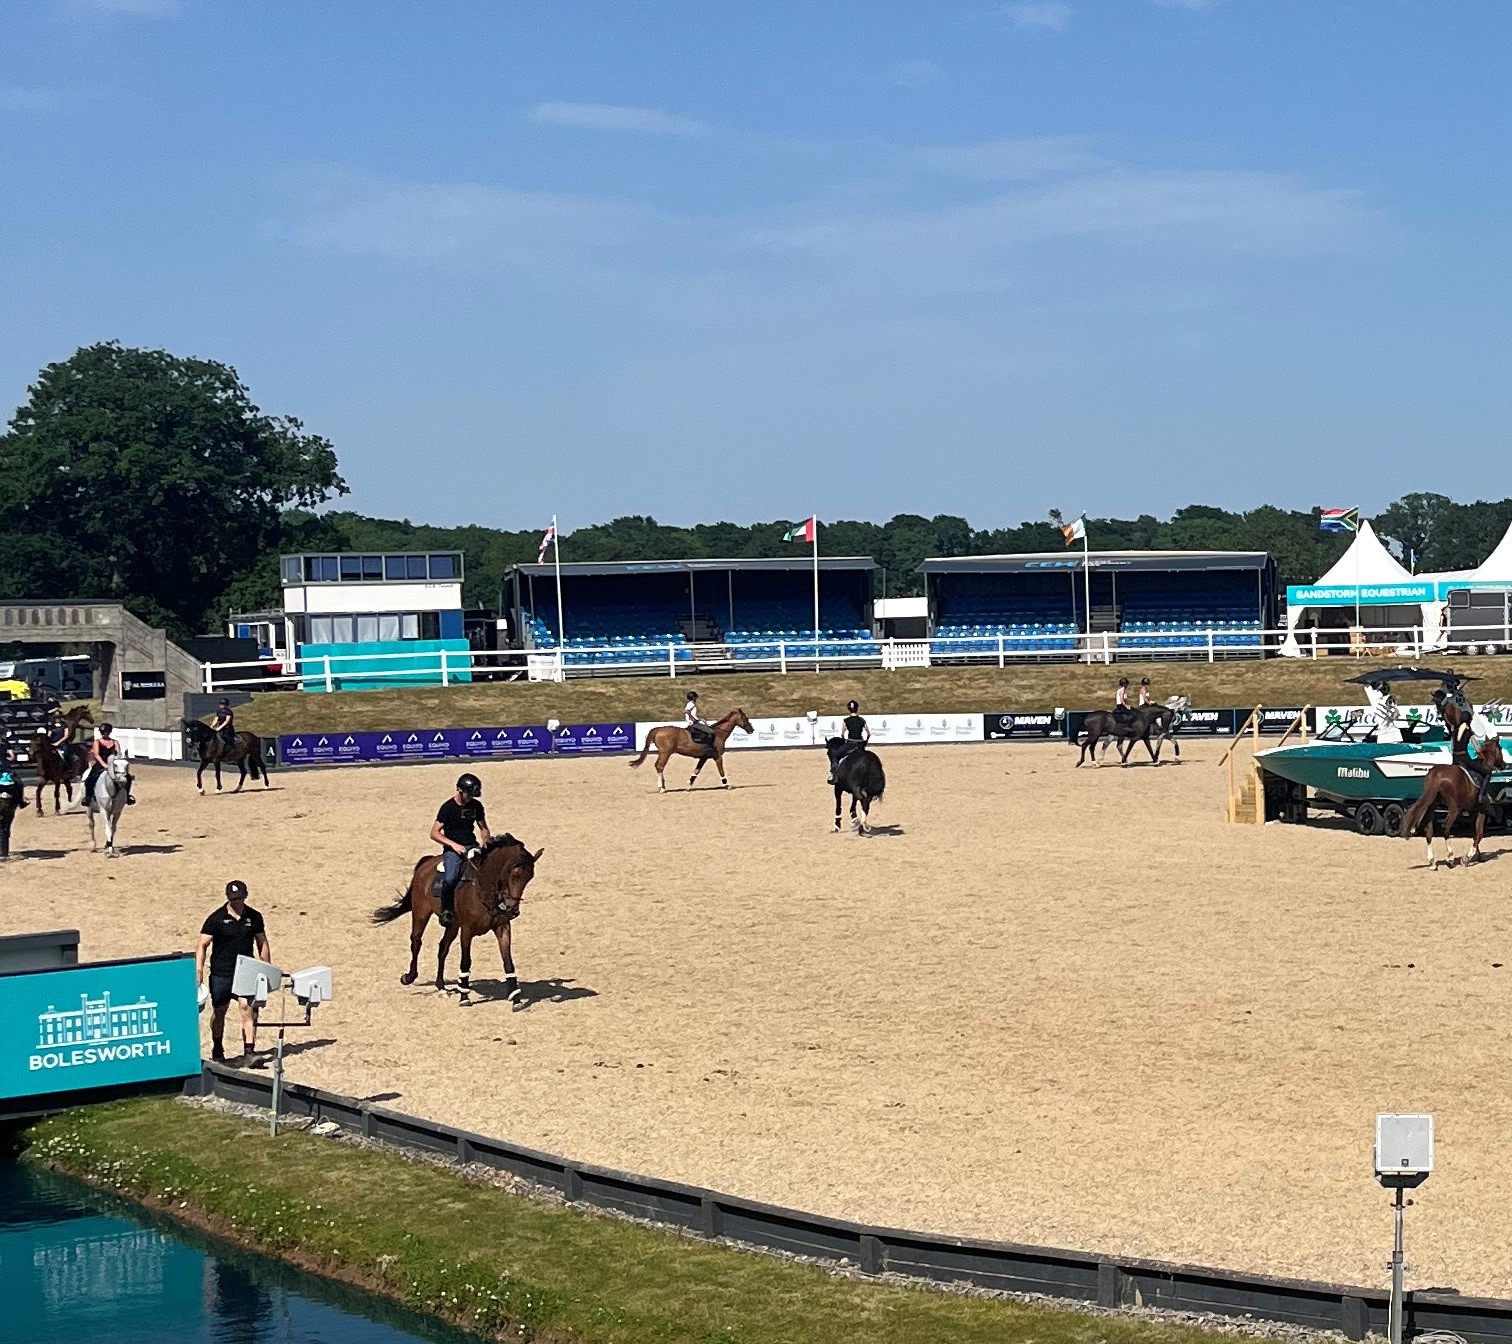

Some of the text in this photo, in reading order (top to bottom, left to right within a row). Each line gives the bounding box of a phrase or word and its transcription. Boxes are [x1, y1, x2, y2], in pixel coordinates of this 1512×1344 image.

[1296, 588, 1425, 599] SANDSTORM EQUESTRIAN
[1015, 716, 1052, 724] MAVEN
[1337, 766, 1370, 778] Malibu
[30, 1040, 170, 1070] BOLESWORTH
